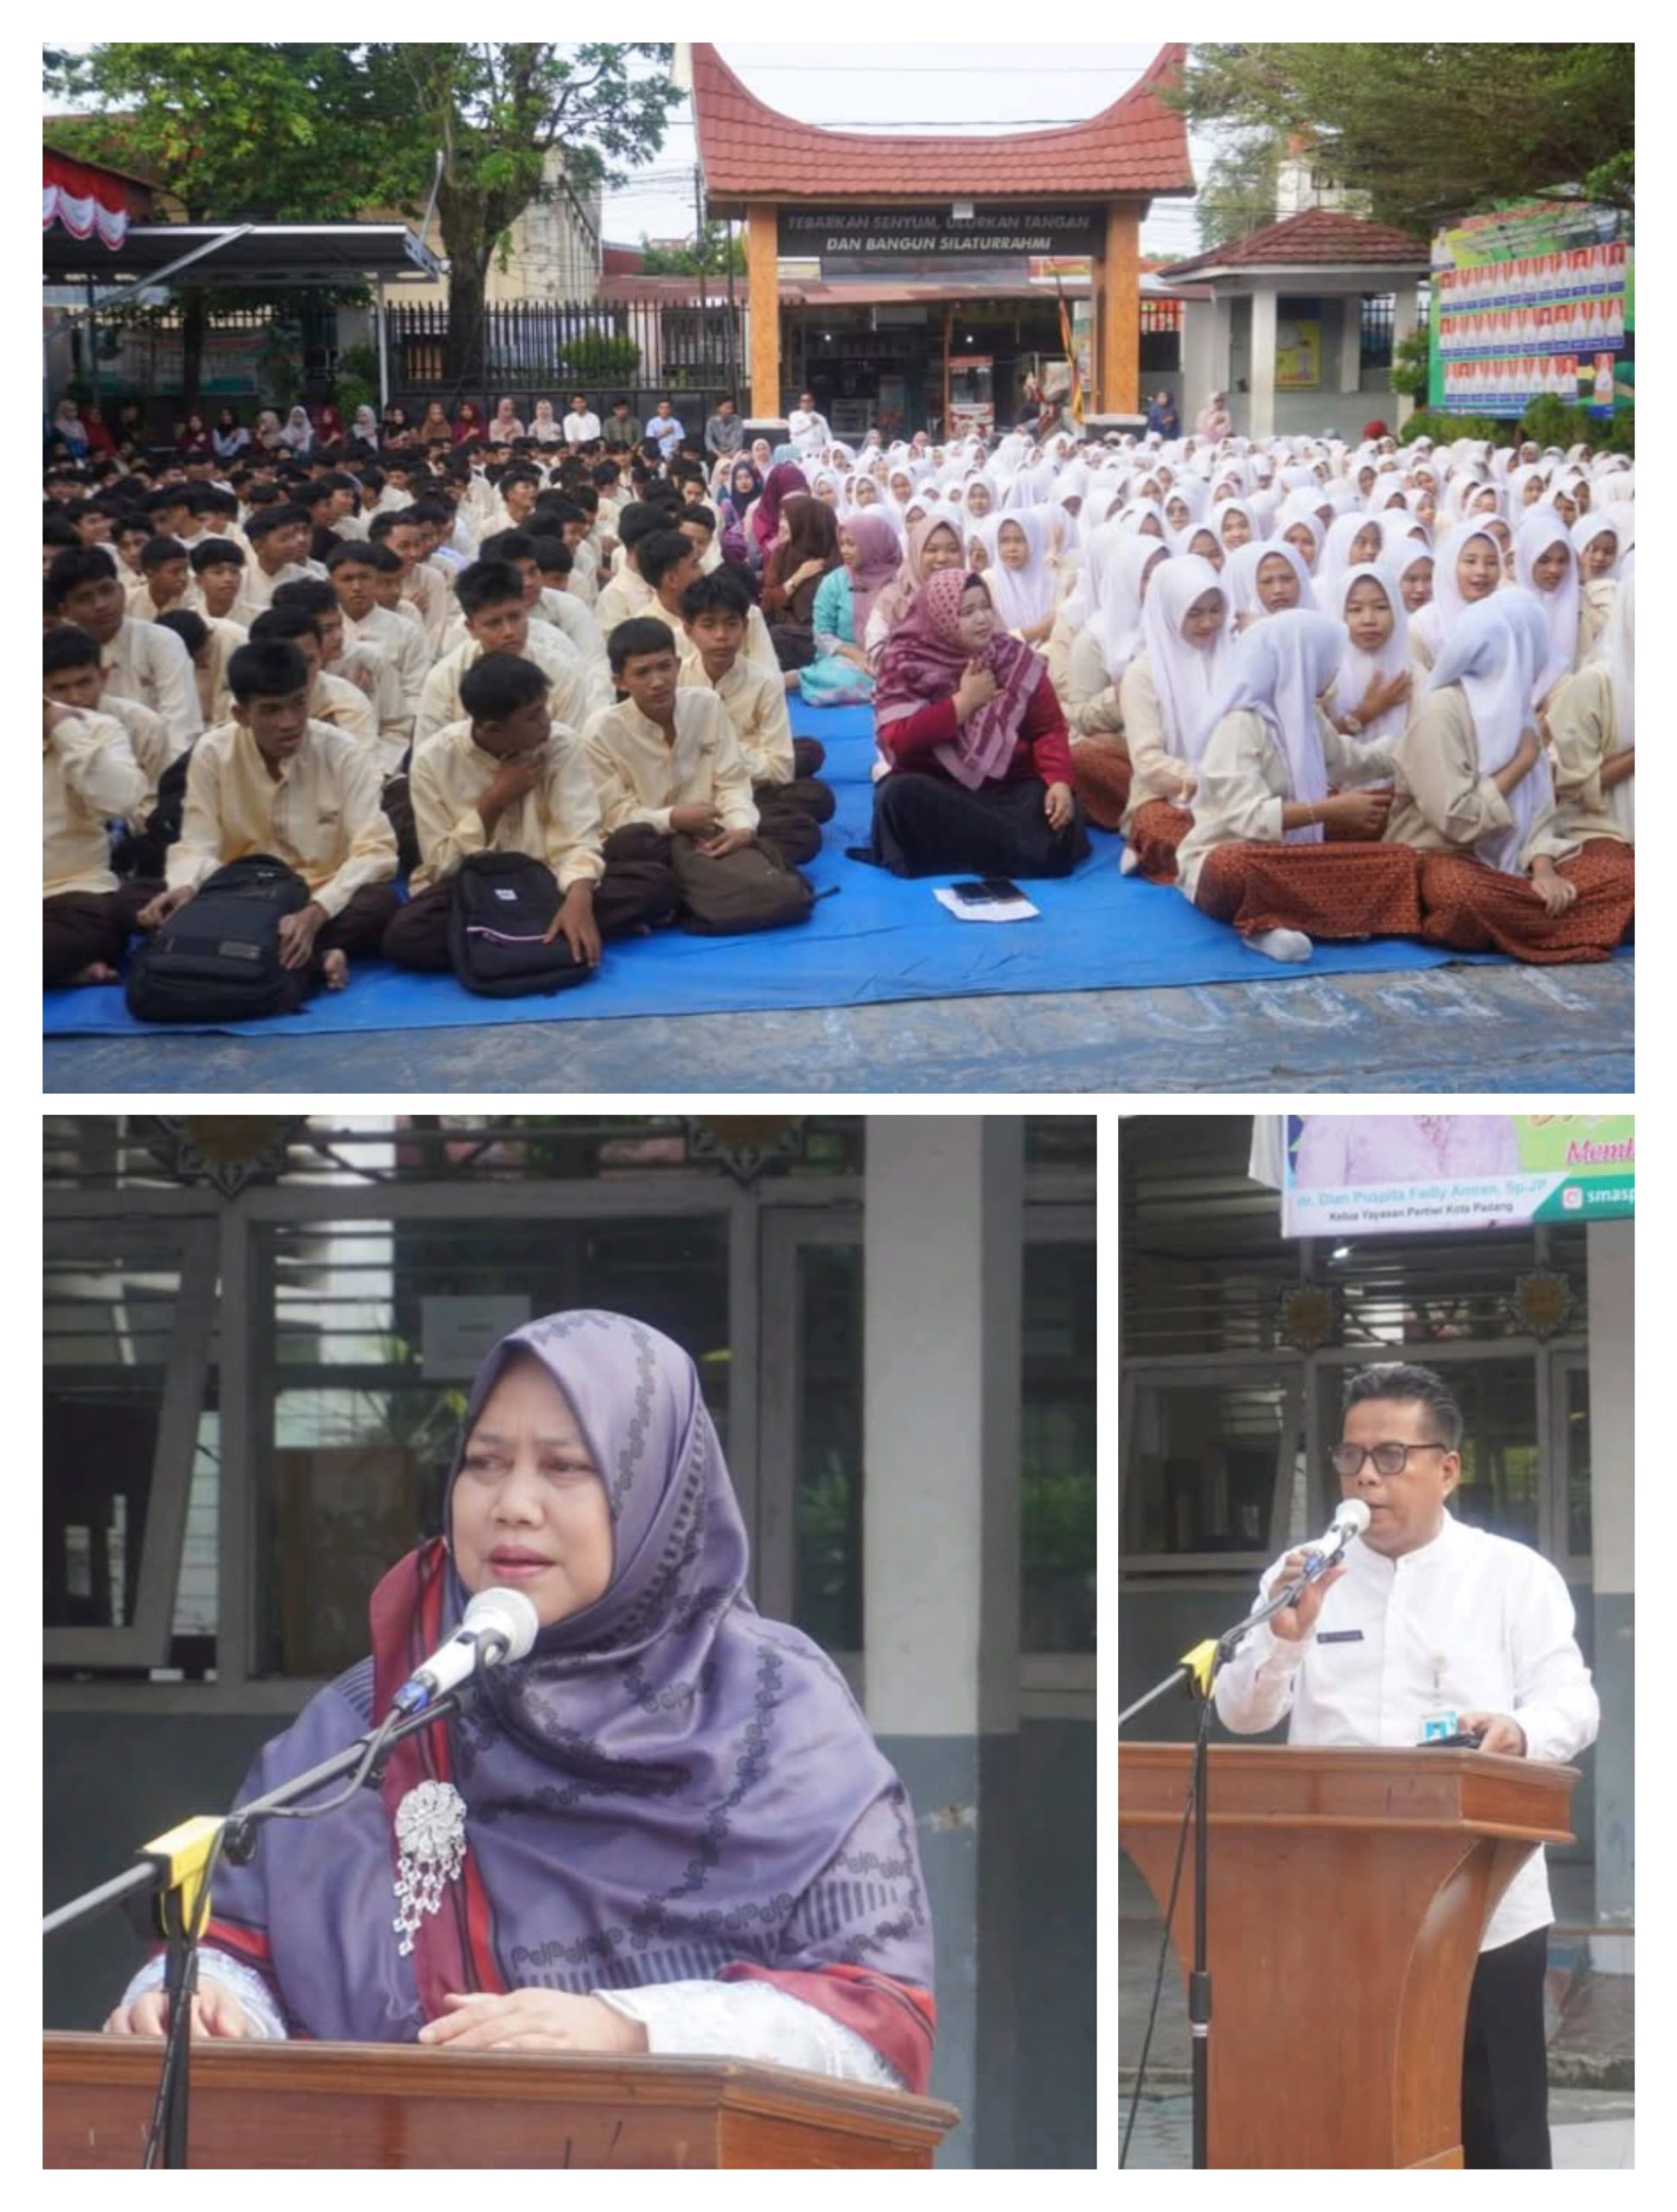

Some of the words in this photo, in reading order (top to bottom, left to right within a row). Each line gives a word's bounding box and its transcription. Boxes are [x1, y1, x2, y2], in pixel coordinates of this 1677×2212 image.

[787, 215, 868, 230] TEBARKAN
[1024, 215, 1090, 230] TANGAN
[826, 238, 862, 251] DAN
[866, 238, 936, 251] BANGUN
[939, 237, 1051, 250] SILATURRAHMI
[1318, 1192, 1350, 1206] Dian
[1329, 1211, 1359, 1222] Ketua
[1363, 1209, 1404, 1222] Yayasan
[1445, 1205, 1471, 1215] Kota
[1473, 1202, 1514, 1215] Padang
